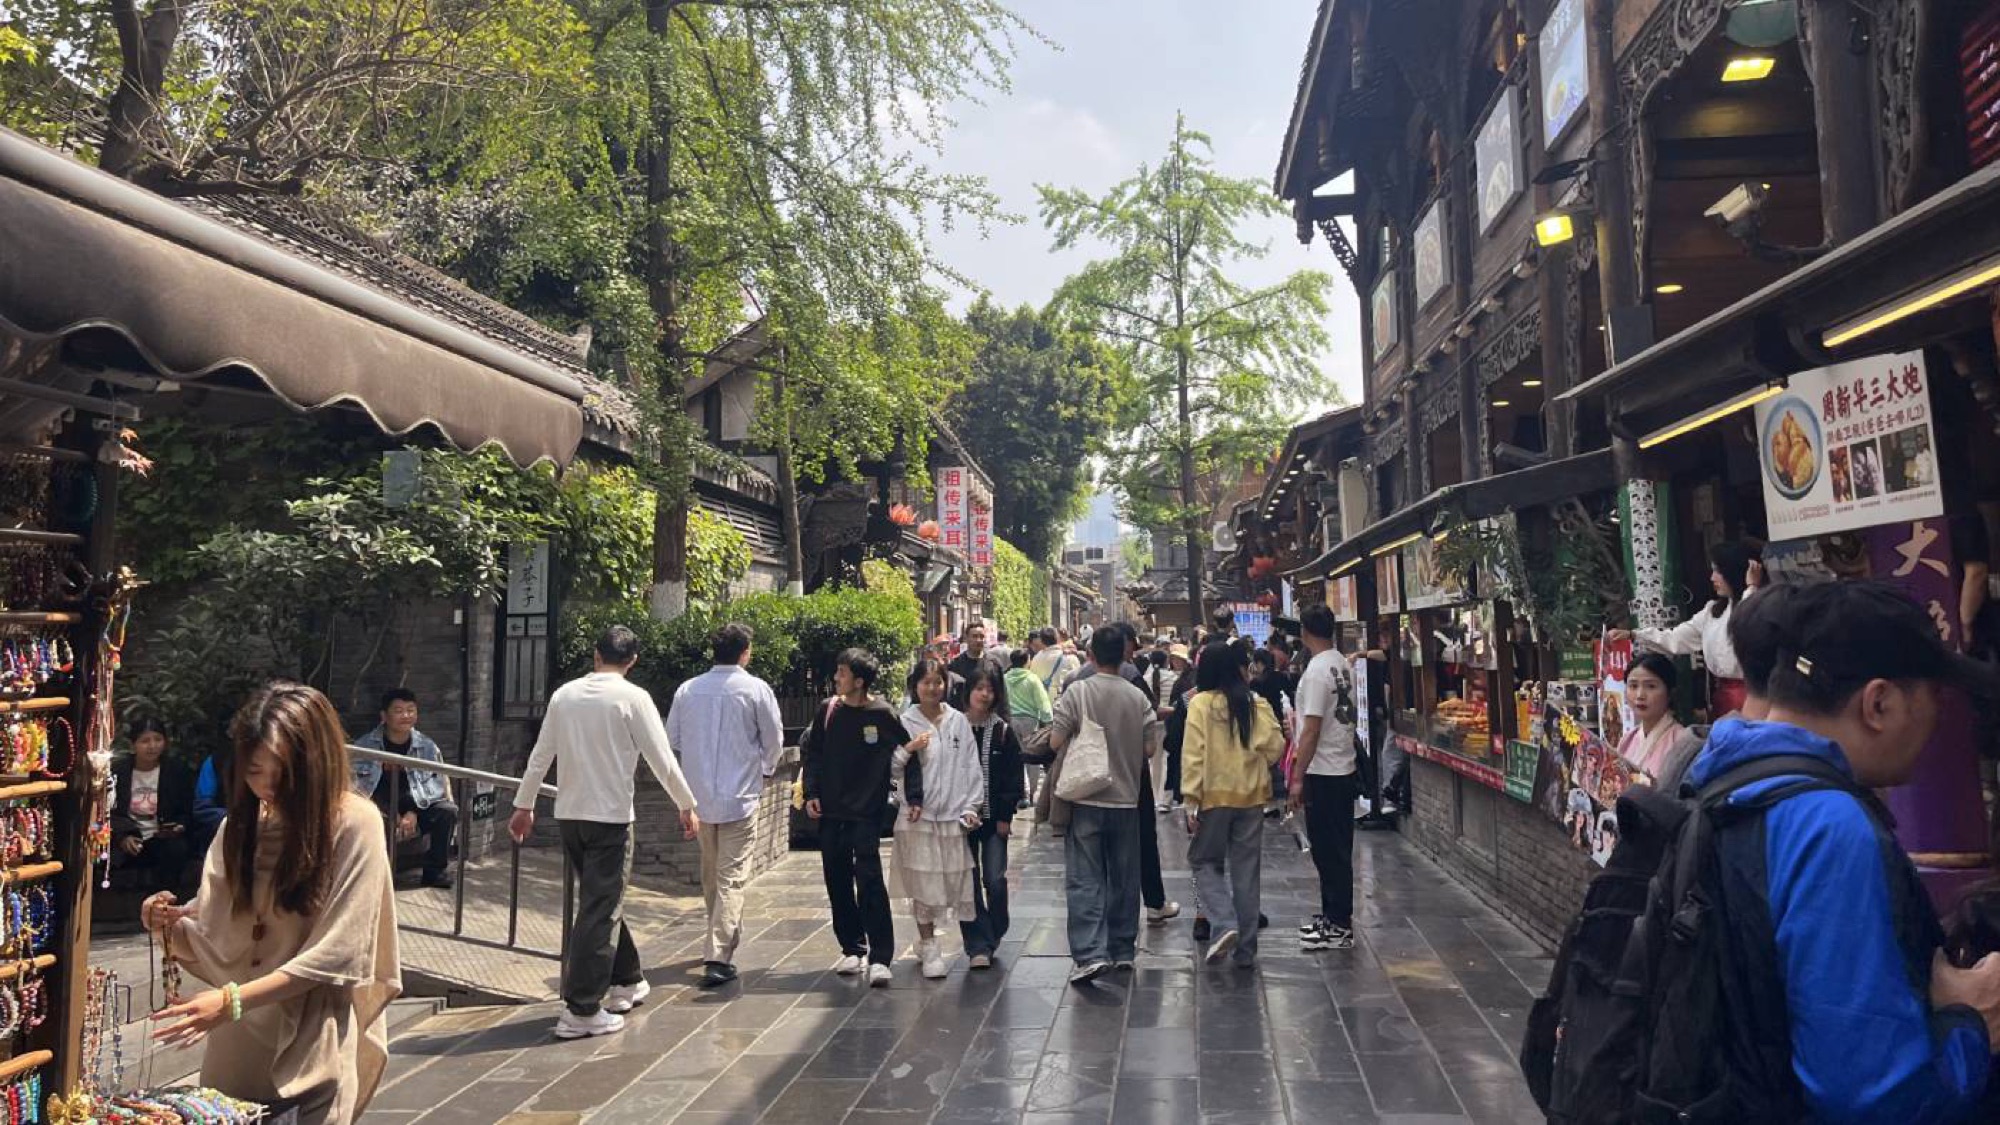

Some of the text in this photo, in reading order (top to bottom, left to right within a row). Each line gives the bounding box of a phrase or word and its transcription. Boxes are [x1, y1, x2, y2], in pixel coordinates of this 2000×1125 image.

[1822, 361, 1923, 422] 周新华三大炮
